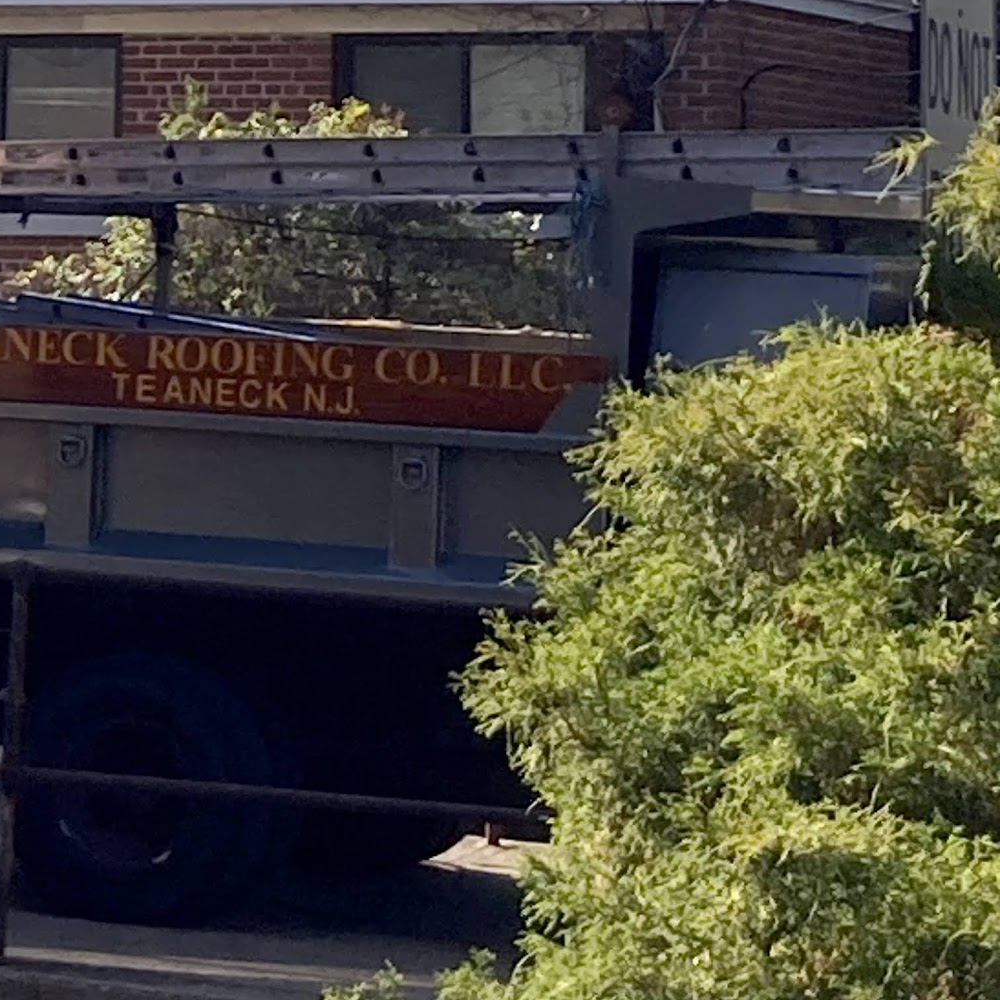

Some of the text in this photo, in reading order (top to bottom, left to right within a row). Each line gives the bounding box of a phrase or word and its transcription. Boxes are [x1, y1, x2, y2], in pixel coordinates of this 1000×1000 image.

[927, 18, 991, 121] DO NOT
[146, 335, 356, 381] ROOFING
[374, 348, 448, 386] CO.
[110, 371, 361, 416] TEANECK N.J.
